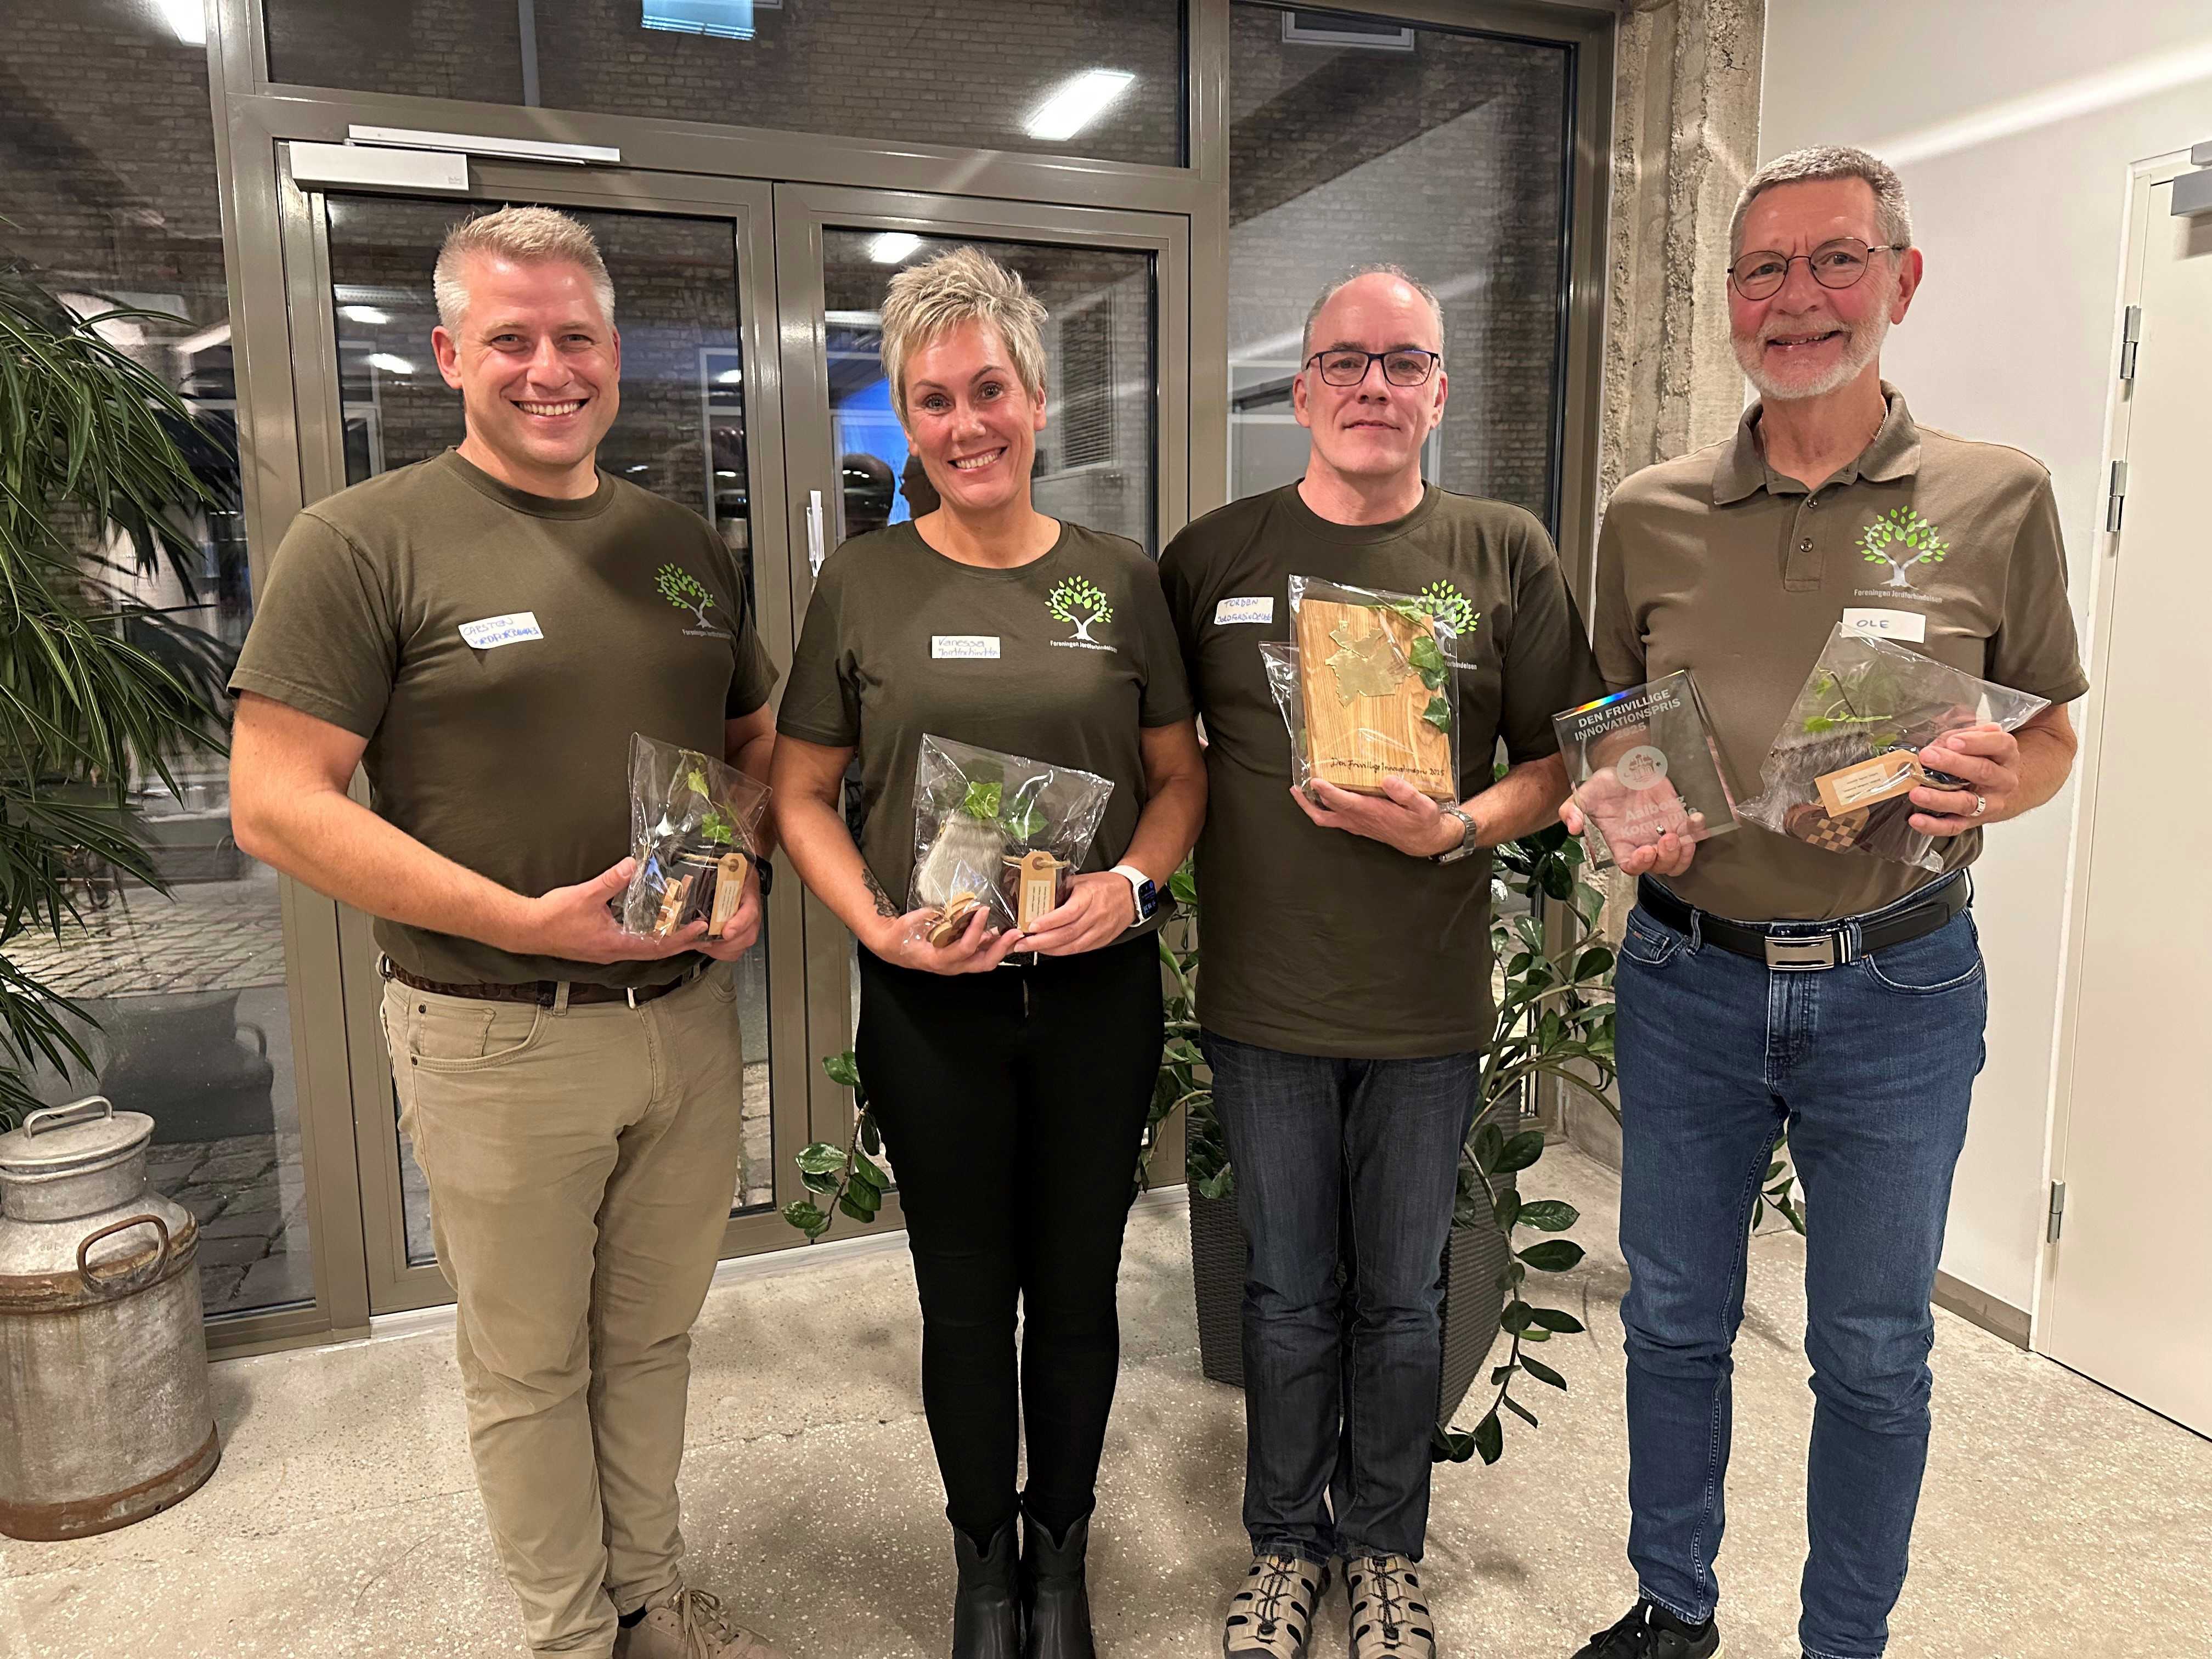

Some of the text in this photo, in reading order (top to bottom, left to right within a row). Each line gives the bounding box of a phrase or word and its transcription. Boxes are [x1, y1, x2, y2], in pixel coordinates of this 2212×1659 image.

[1224, 599, 1259, 608] TORBEN
[1854, 589, 1943, 603] Foreningen Jordforbindelsen
[463, 617, 513, 635] CARSTEN
[1857, 619, 1889, 628] OLE
[939, 636, 985, 647] Vanessa
[1578, 689, 1671, 728] DEN FRIVILLIGE
[1574, 698, 1681, 741] INNOVATIONSPRIS
[1615, 721, 1647, 740] 2025
[1330, 757, 1346, 768] Den
[1430, 768, 1444, 776] 2025
[1626, 795, 1687, 822] Aalborg
